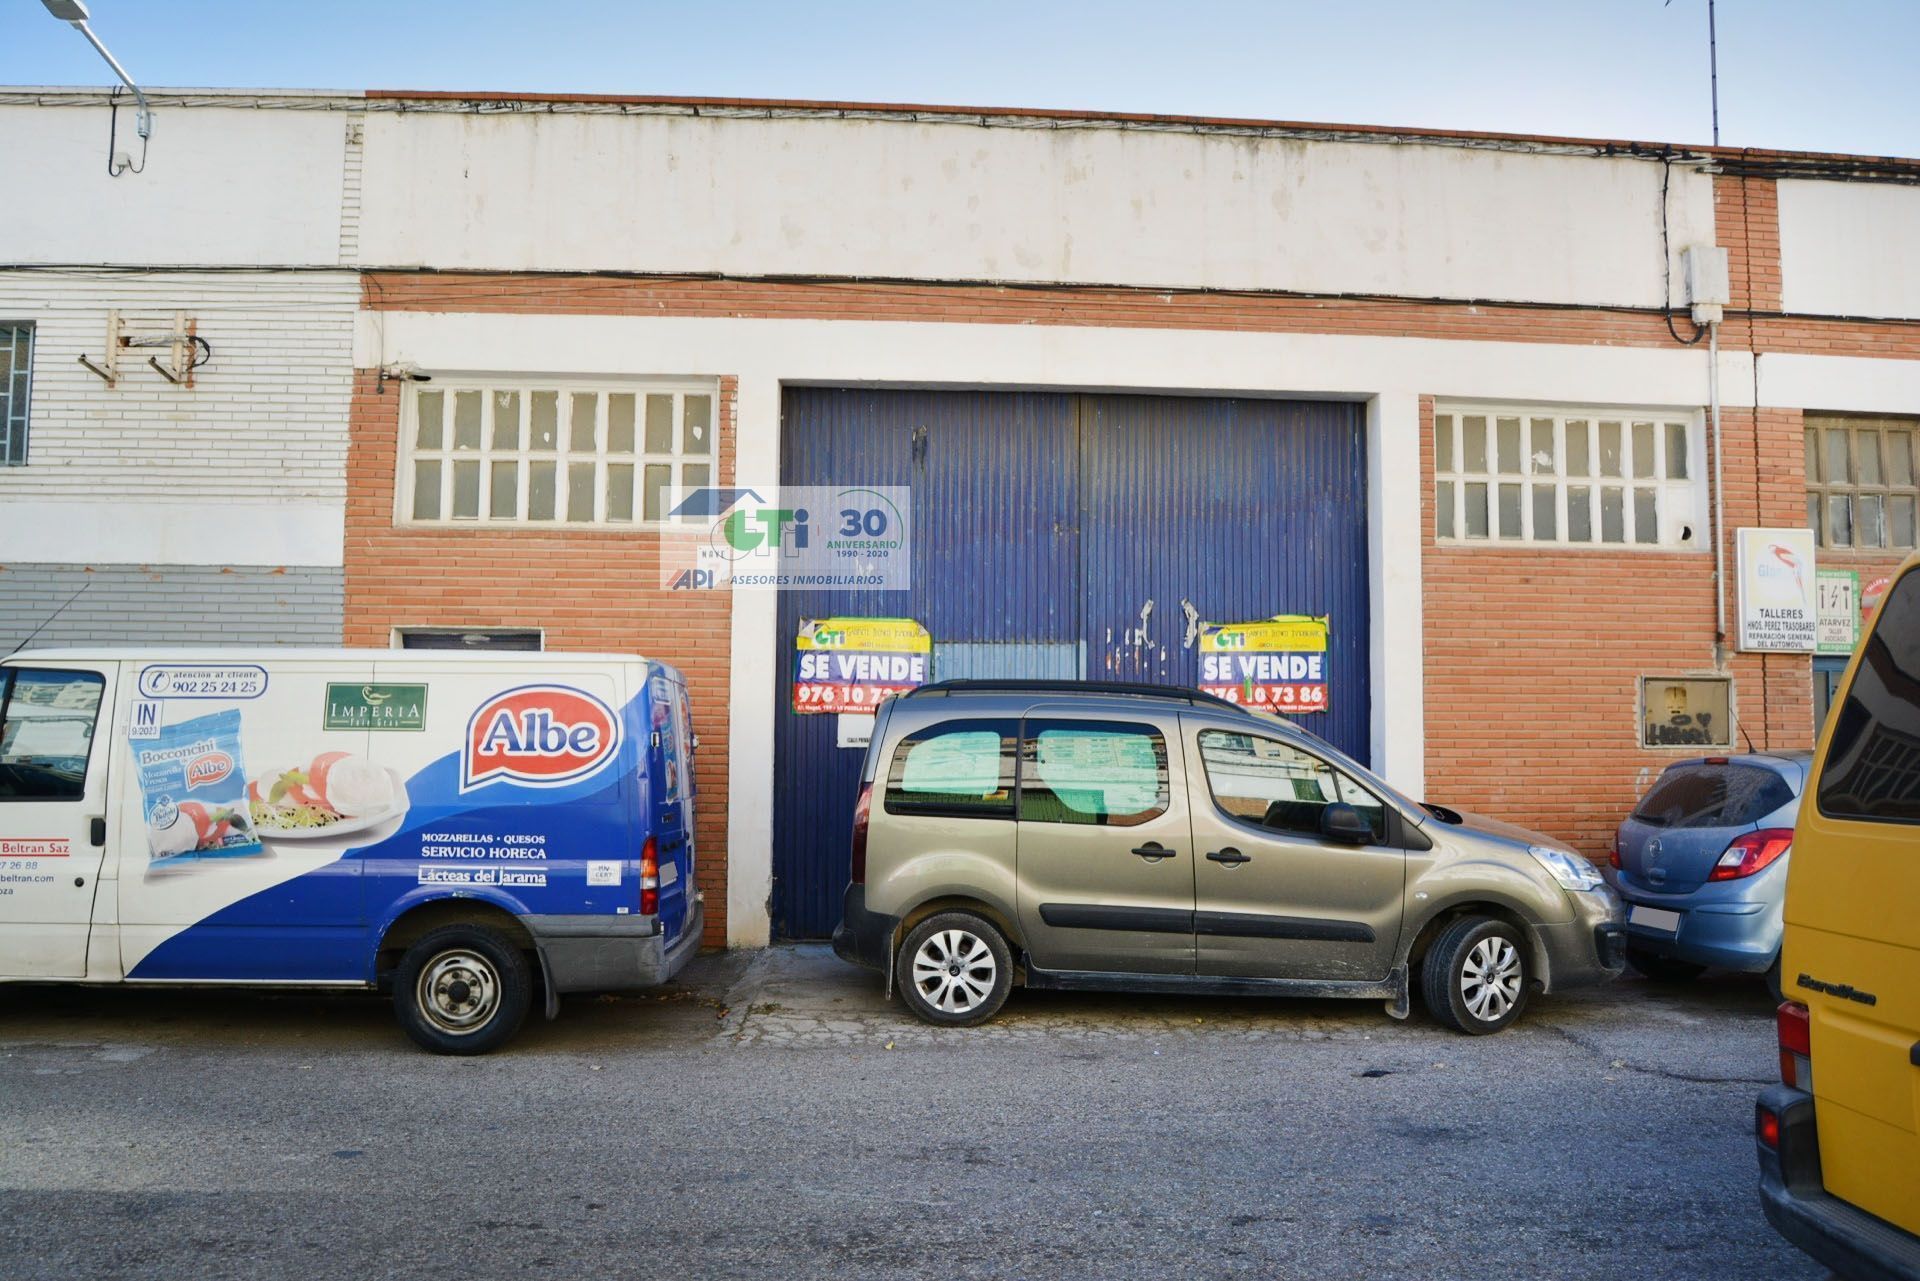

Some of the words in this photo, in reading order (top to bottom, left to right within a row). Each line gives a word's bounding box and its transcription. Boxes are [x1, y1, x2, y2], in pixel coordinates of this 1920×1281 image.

[1760, 608, 1803, 619] TALLERES
[1764, 621, 1781, 631] PEREZ
[1819, 618, 1851, 627] ATARVEZ
[1787, 633, 1814, 641] GENERAL
[1757, 640, 1769, 648] DEL
[800, 654, 830, 680] SE
[837, 654, 924, 682] VENDE
[1203, 656, 1232, 681] SE
[1238, 656, 1322, 680] VENDE
[172, 681, 197, 693] 902
[201, 681, 217, 693] 25
[220, 682, 236, 693] 24
[240, 682, 257, 693] 25
[798, 685, 835, 703] 976
[841, 687, 864, 704] 10
[1271, 686, 1295, 703] 73
[1299, 686, 1323, 703] 86
[137, 703, 156, 726] IN
[331, 703, 420, 718] IMPERIA
[482, 712, 597, 753] Albe
[142, 740, 215, 765] Bocconcini
[192, 762, 226, 777] Albe
[421, 833, 494, 844] MOZZARELLAS
[503, 834, 546, 845] QUESOS
[2, 842, 45, 853] Beltran
[49, 842, 70, 853] Saz
[421, 846, 486, 858] SERVICIO
[489, 847, 547, 859] HORECA
[10, 861, 22, 870] 26
[25, 861, 38, 870] 88
[418, 868, 471, 882] Lácteas
[474, 869, 495, 882] del
